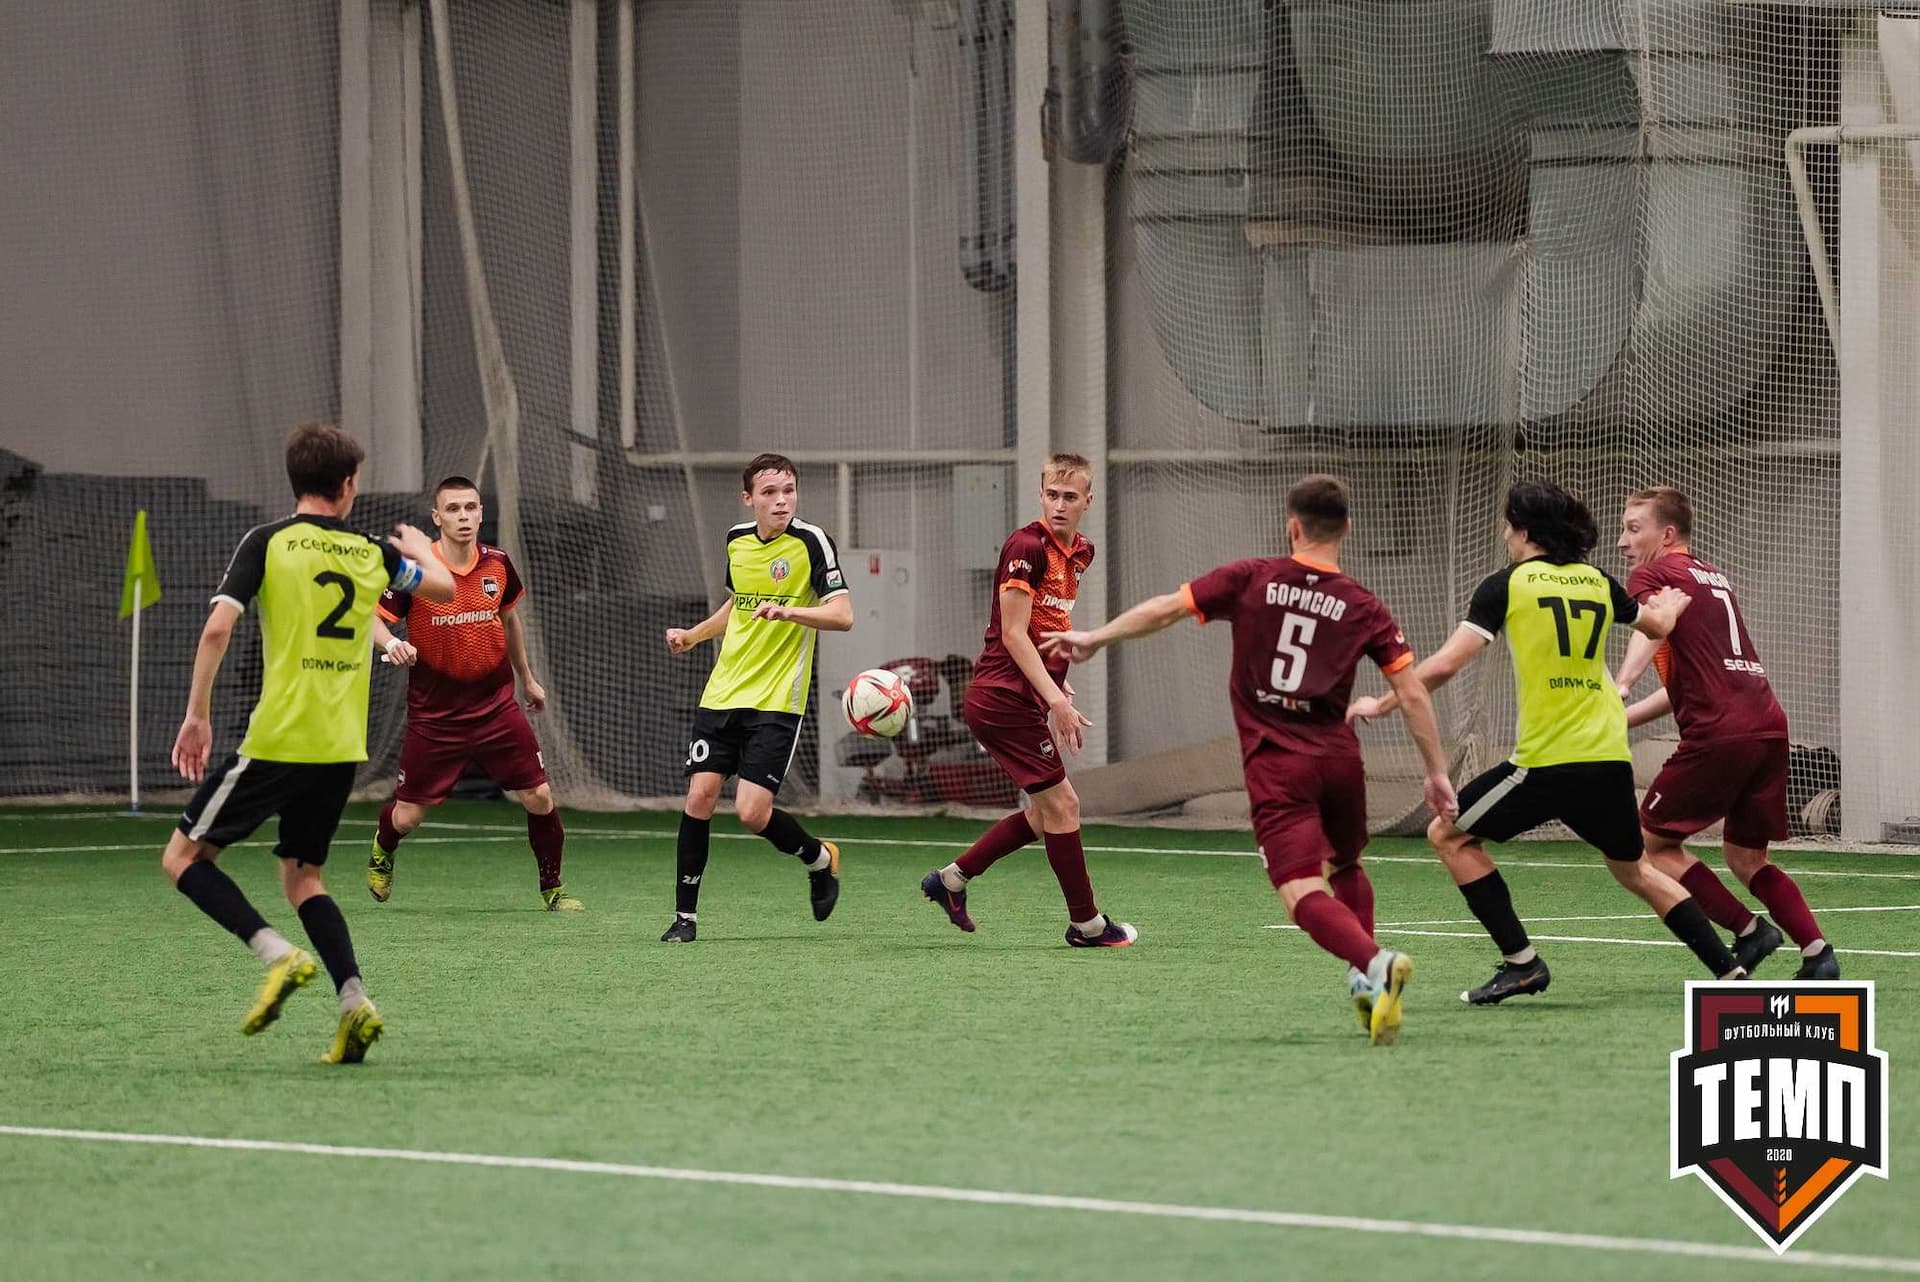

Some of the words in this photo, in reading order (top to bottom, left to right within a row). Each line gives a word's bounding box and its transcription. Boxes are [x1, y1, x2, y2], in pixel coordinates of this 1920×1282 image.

[313, 570, 355, 640] 2
[1265, 582, 1347, 622] БОРИСОВ
[1537, 596, 1607, 660] 17
[1711, 588, 1742, 656] 7
[1270, 612, 1318, 693] 5
